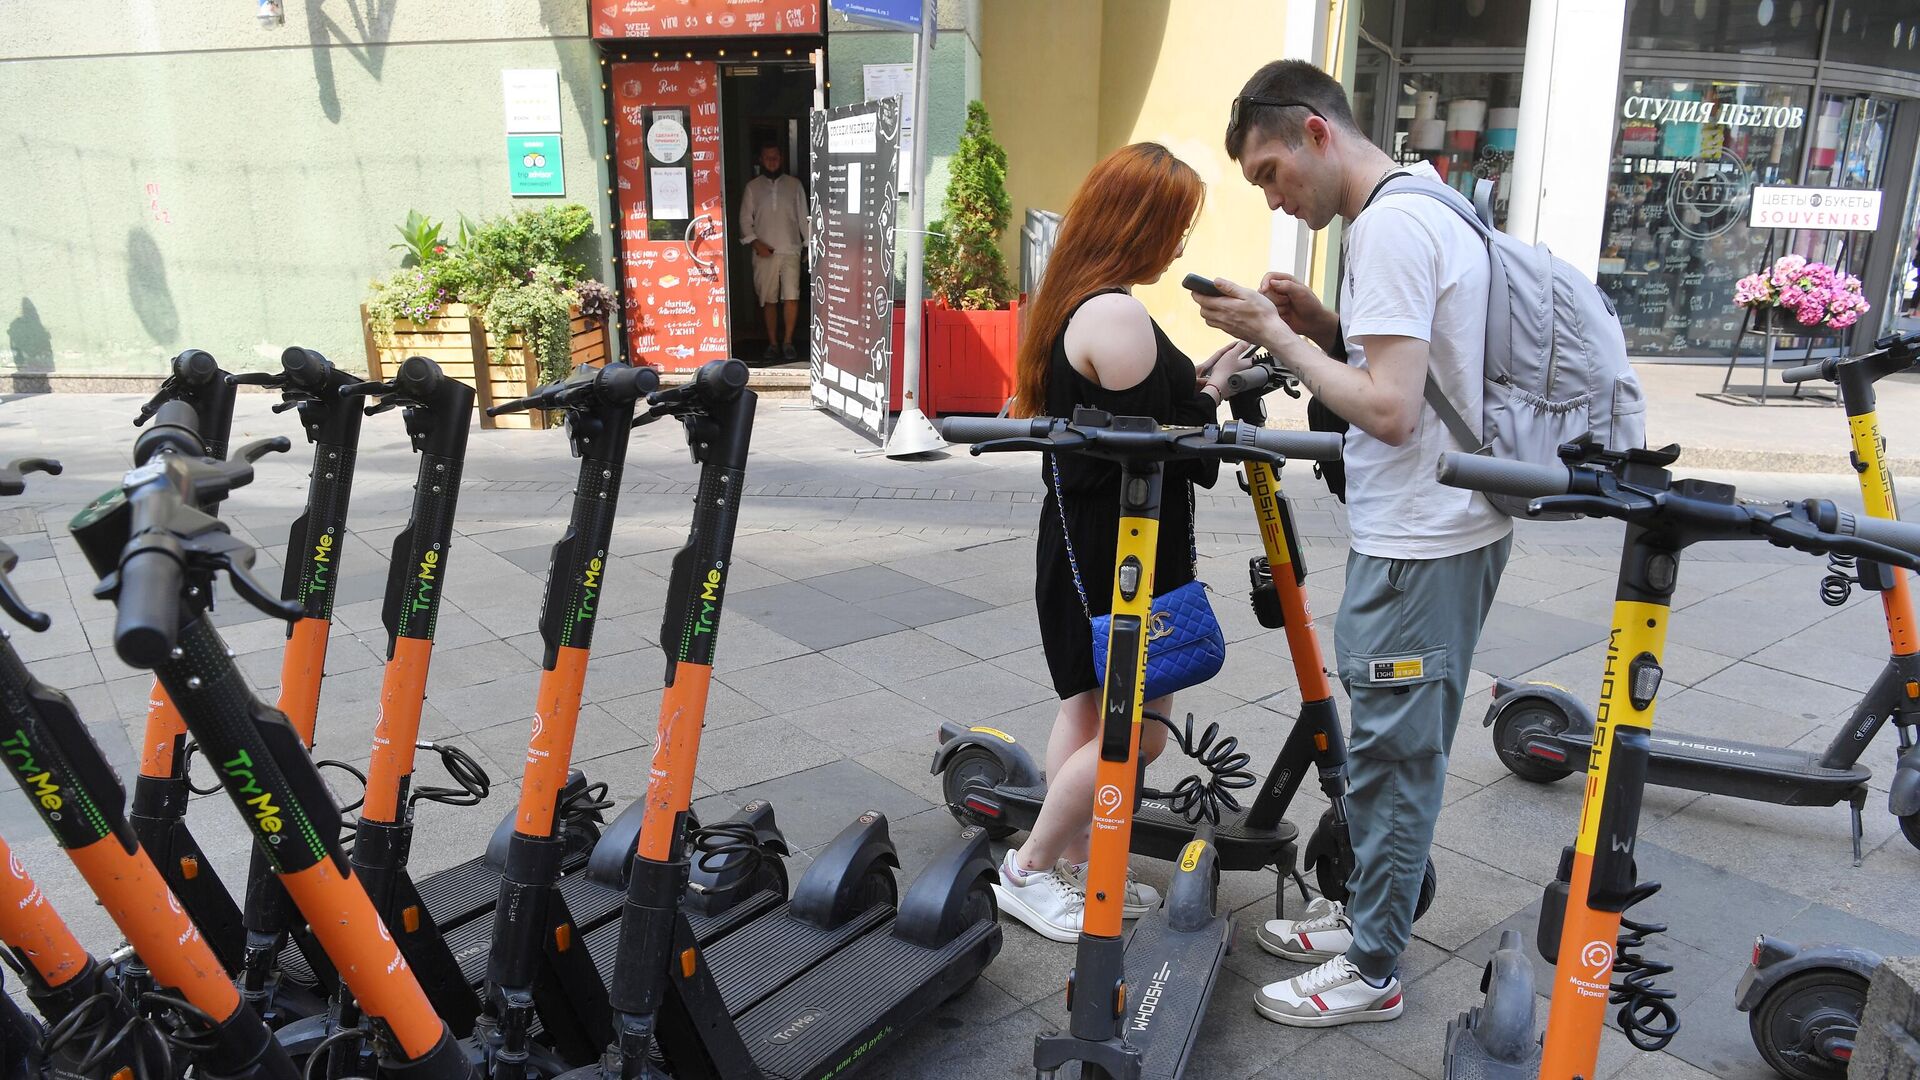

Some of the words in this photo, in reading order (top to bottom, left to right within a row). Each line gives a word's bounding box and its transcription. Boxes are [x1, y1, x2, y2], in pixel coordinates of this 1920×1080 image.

[1623, 96, 1715, 126] СТУДИЯ
[1717, 103, 1804, 129] ЦВЕТОВ
[1760, 210, 1871, 226] SOUVENIRS
[1762, 193, 1807, 206] ЦВЕТЫ
[1824, 196, 1873, 208] БУКЕТЫ
[1871, 424, 1890, 492] WHOOSH
[1253, 461, 1276, 521] HOOSH
[309, 533, 333, 594] TryMe
[412, 549, 439, 613] TryMe
[577, 556, 602, 623] TryMe
[694, 568, 721, 636] TryMe
[1590, 628, 1622, 770] WHOOSH
[1, 729, 63, 811] TryMe
[1682, 741, 1756, 757] WHOOSH
[224, 749, 283, 834] TryMe
[1131, 980, 1166, 1031] WHOOSH
[1577, 987, 1604, 998] Прокат
[774, 1014, 815, 1040] TryMe
[836, 1056, 852, 1072] или
[852, 1044, 868, 1060] 300
